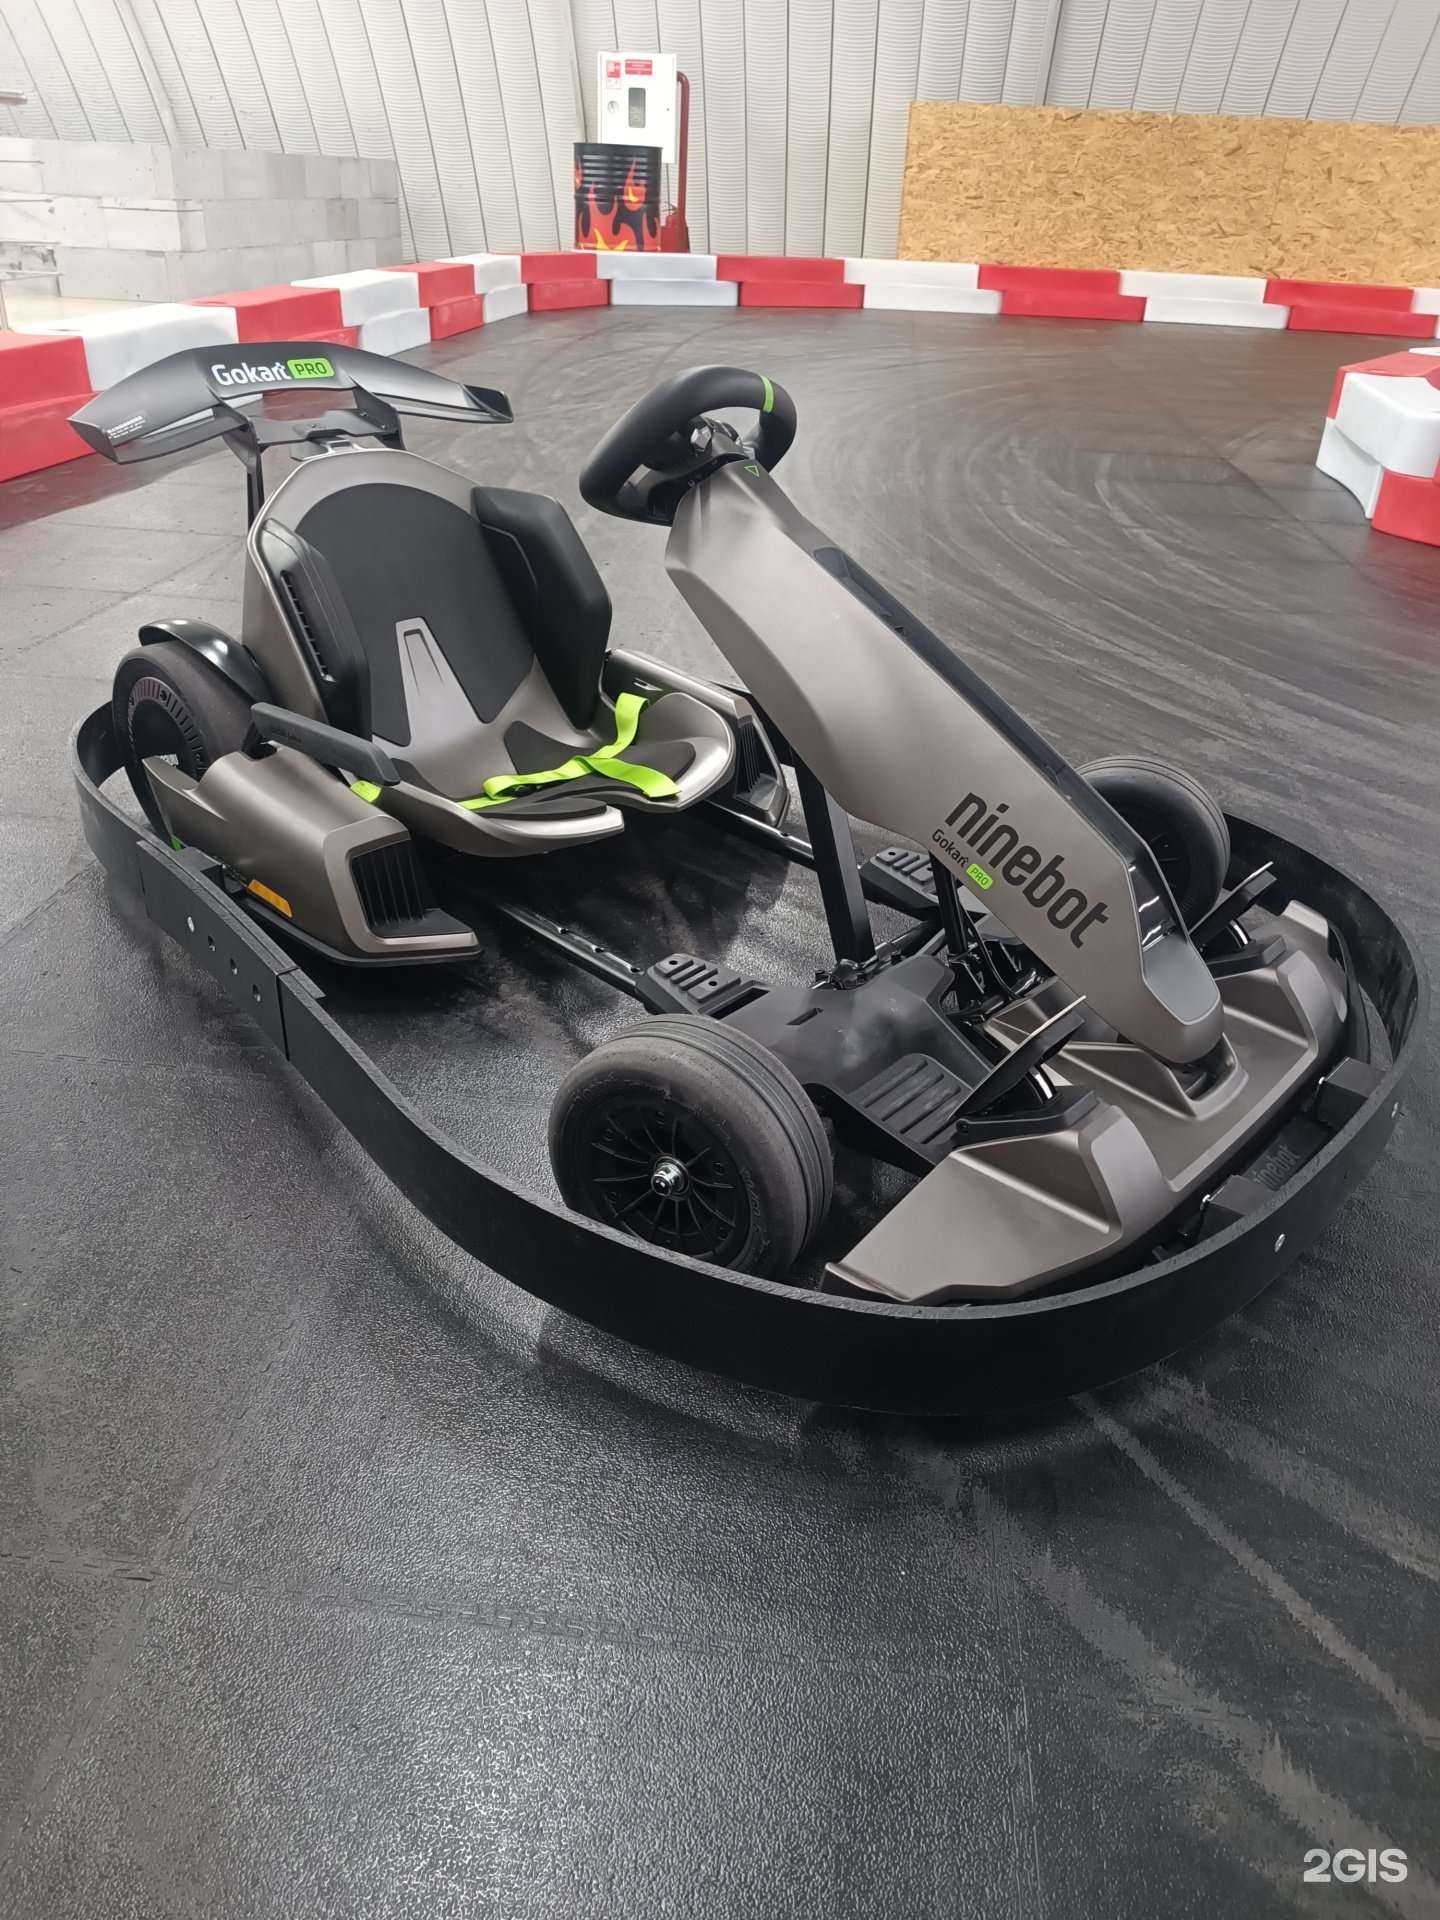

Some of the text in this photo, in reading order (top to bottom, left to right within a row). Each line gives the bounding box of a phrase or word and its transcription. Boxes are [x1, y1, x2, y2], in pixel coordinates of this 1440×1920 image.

[211, 361, 328, 387] Gokart PRO
[932, 828, 989, 887] Gokart PRO
[945, 792, 1109, 948] ninebot
